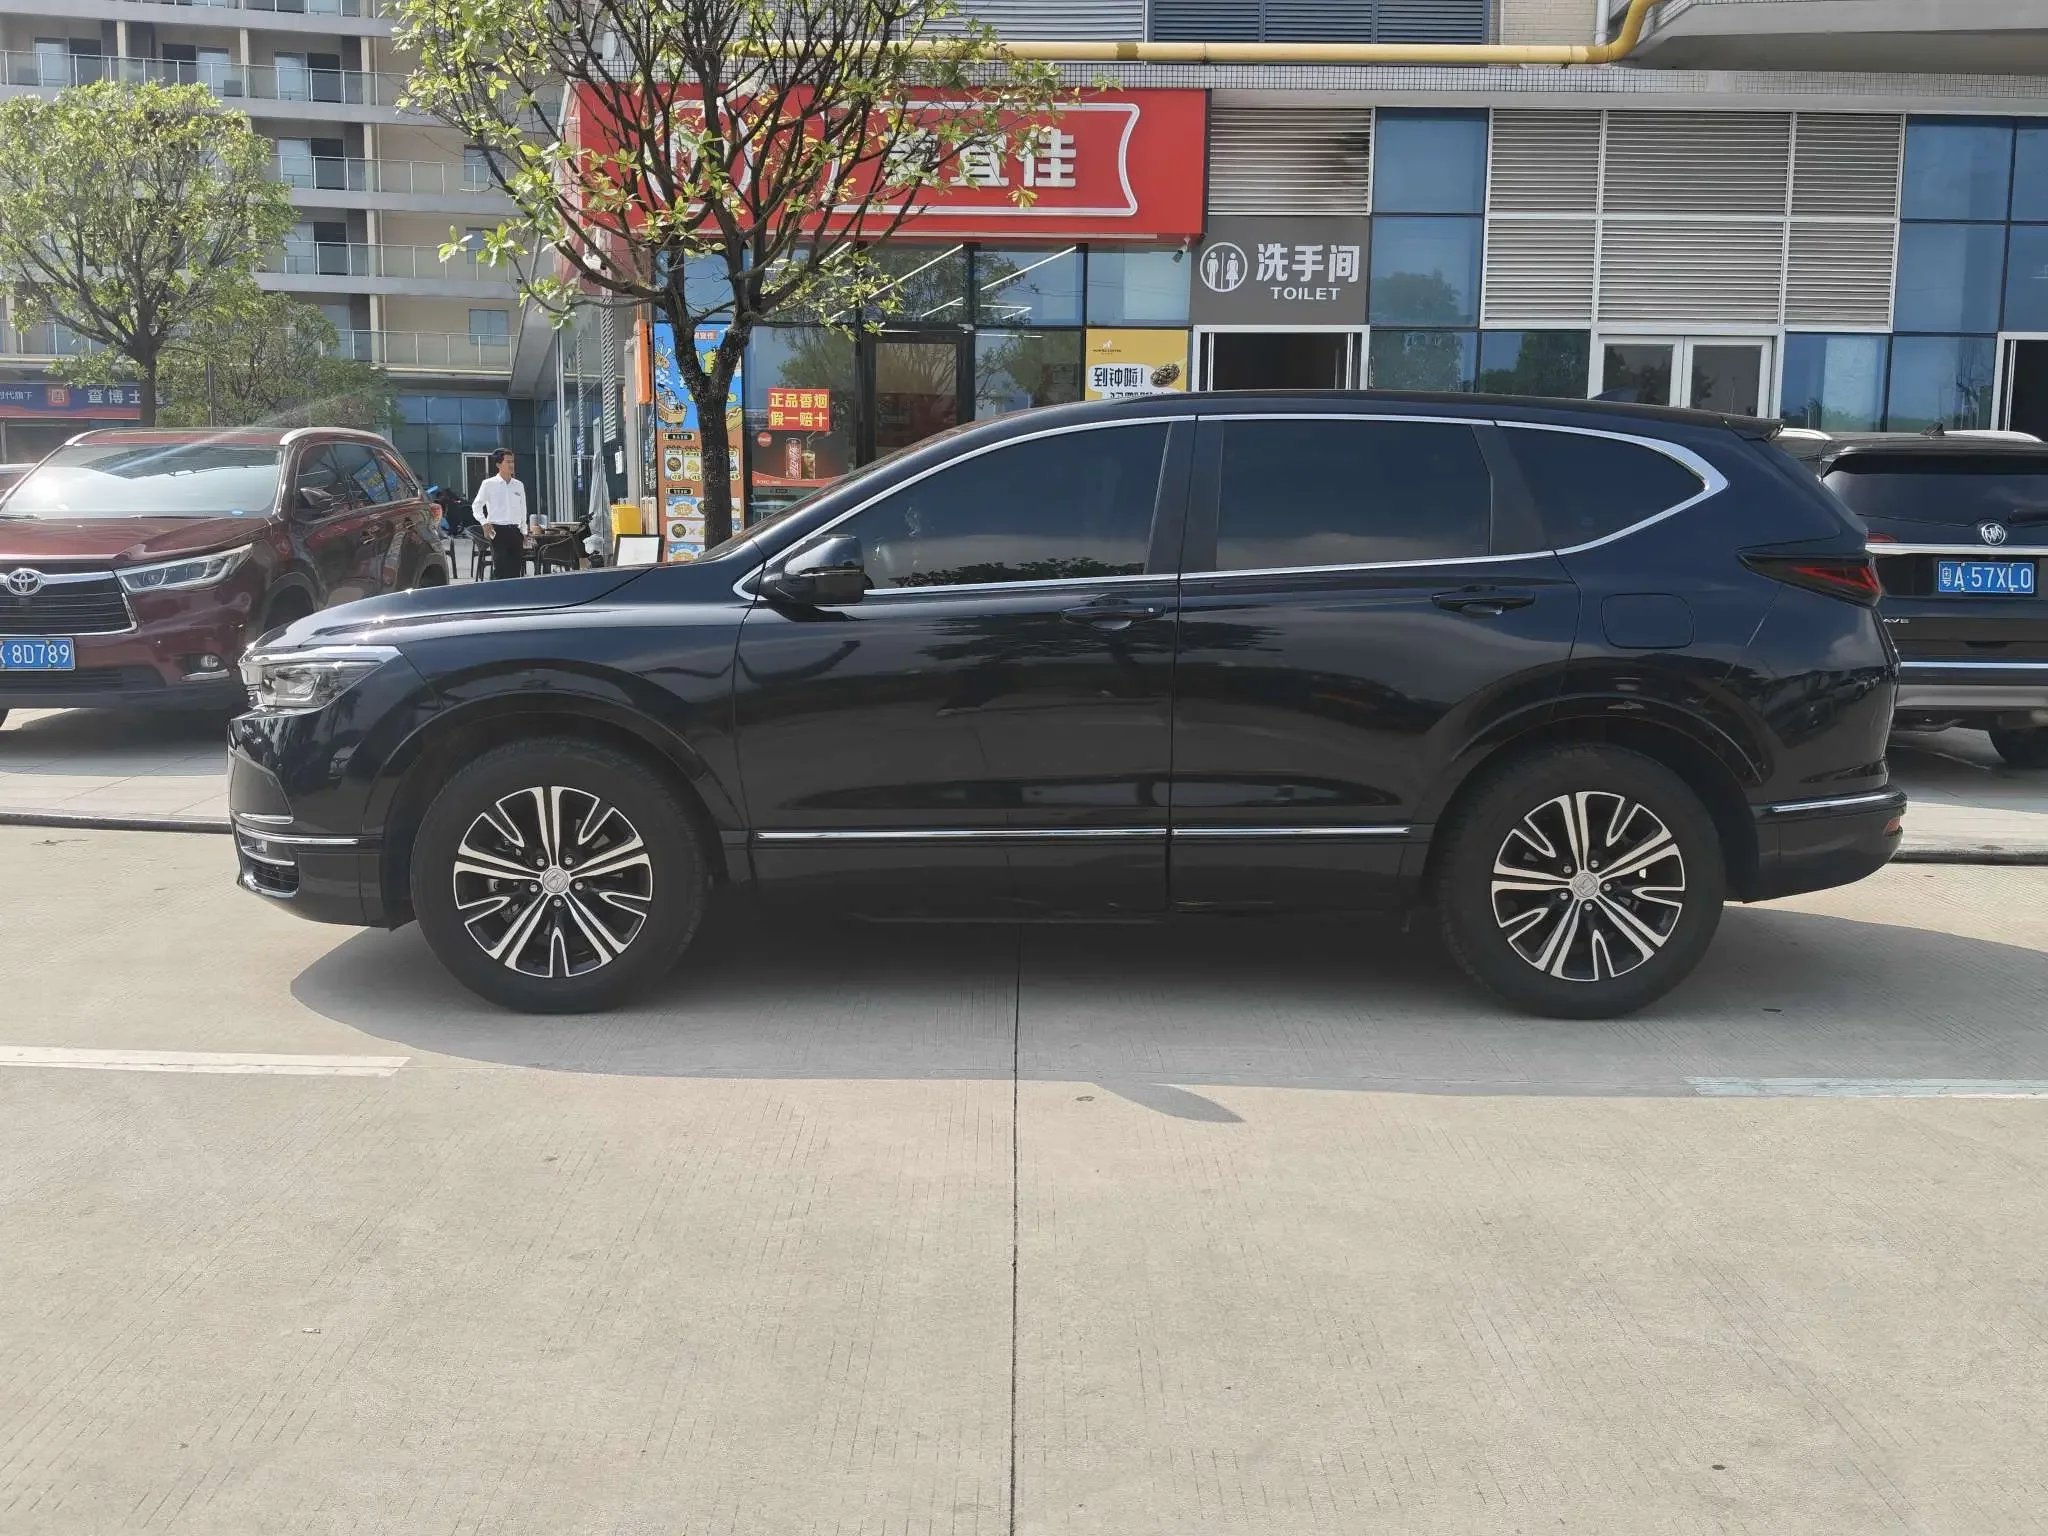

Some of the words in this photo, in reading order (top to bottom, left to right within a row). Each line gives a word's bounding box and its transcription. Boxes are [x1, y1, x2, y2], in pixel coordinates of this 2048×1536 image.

[1255, 242, 1361, 284] 洗手间
[1270, 286, 1341, 301] TOILET
[769, 392, 828, 409] 正品香烟
[769, 410, 828, 428] 假一赔十
